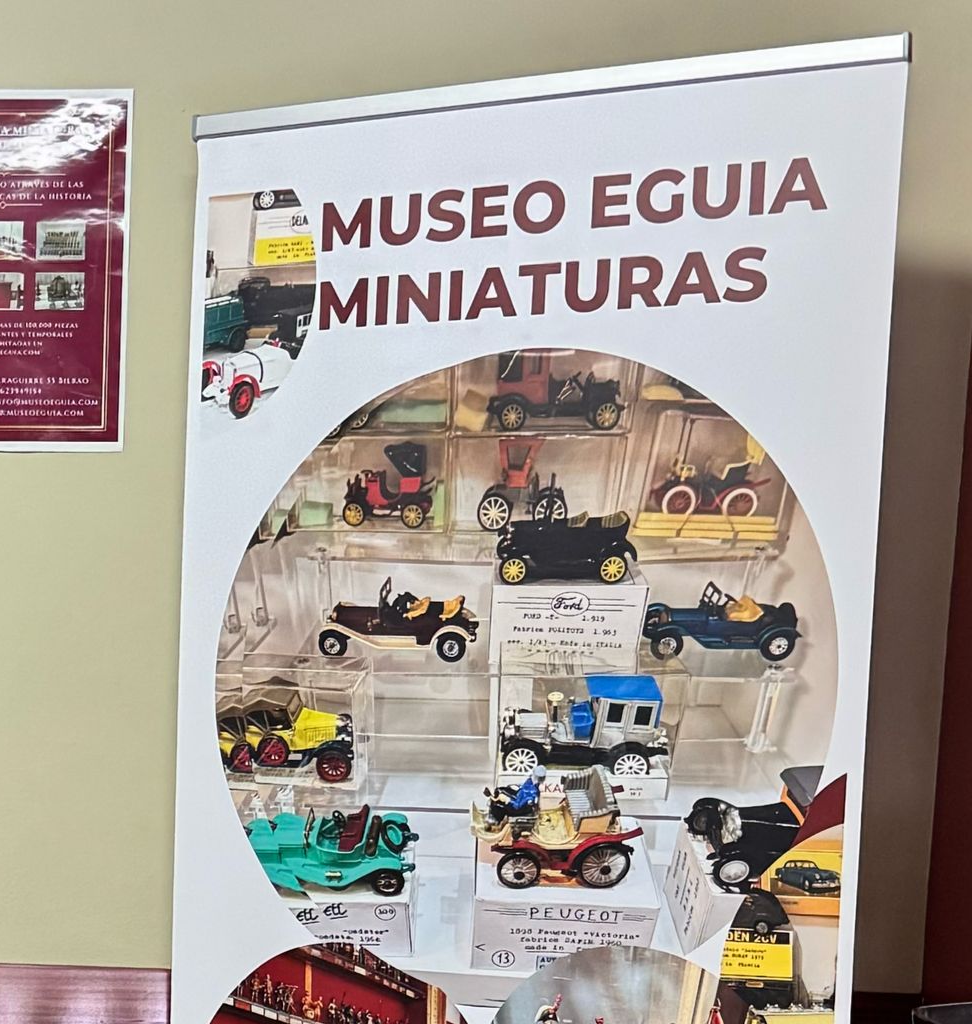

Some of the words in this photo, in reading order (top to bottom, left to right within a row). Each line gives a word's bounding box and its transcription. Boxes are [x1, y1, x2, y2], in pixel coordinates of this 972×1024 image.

[67, 181, 84, 189] LAS
[321, 180, 565, 251] MUSEO
[591, 157, 828, 230] EGUIA
[319, 246, 768, 331] MINIATURAS
[58, 377, 90, 385] BILBAO
[553, 596, 584, 611] Ford
[529, 907, 623, 922] PEUGEOT
[497, 952, 510, 965] 13
